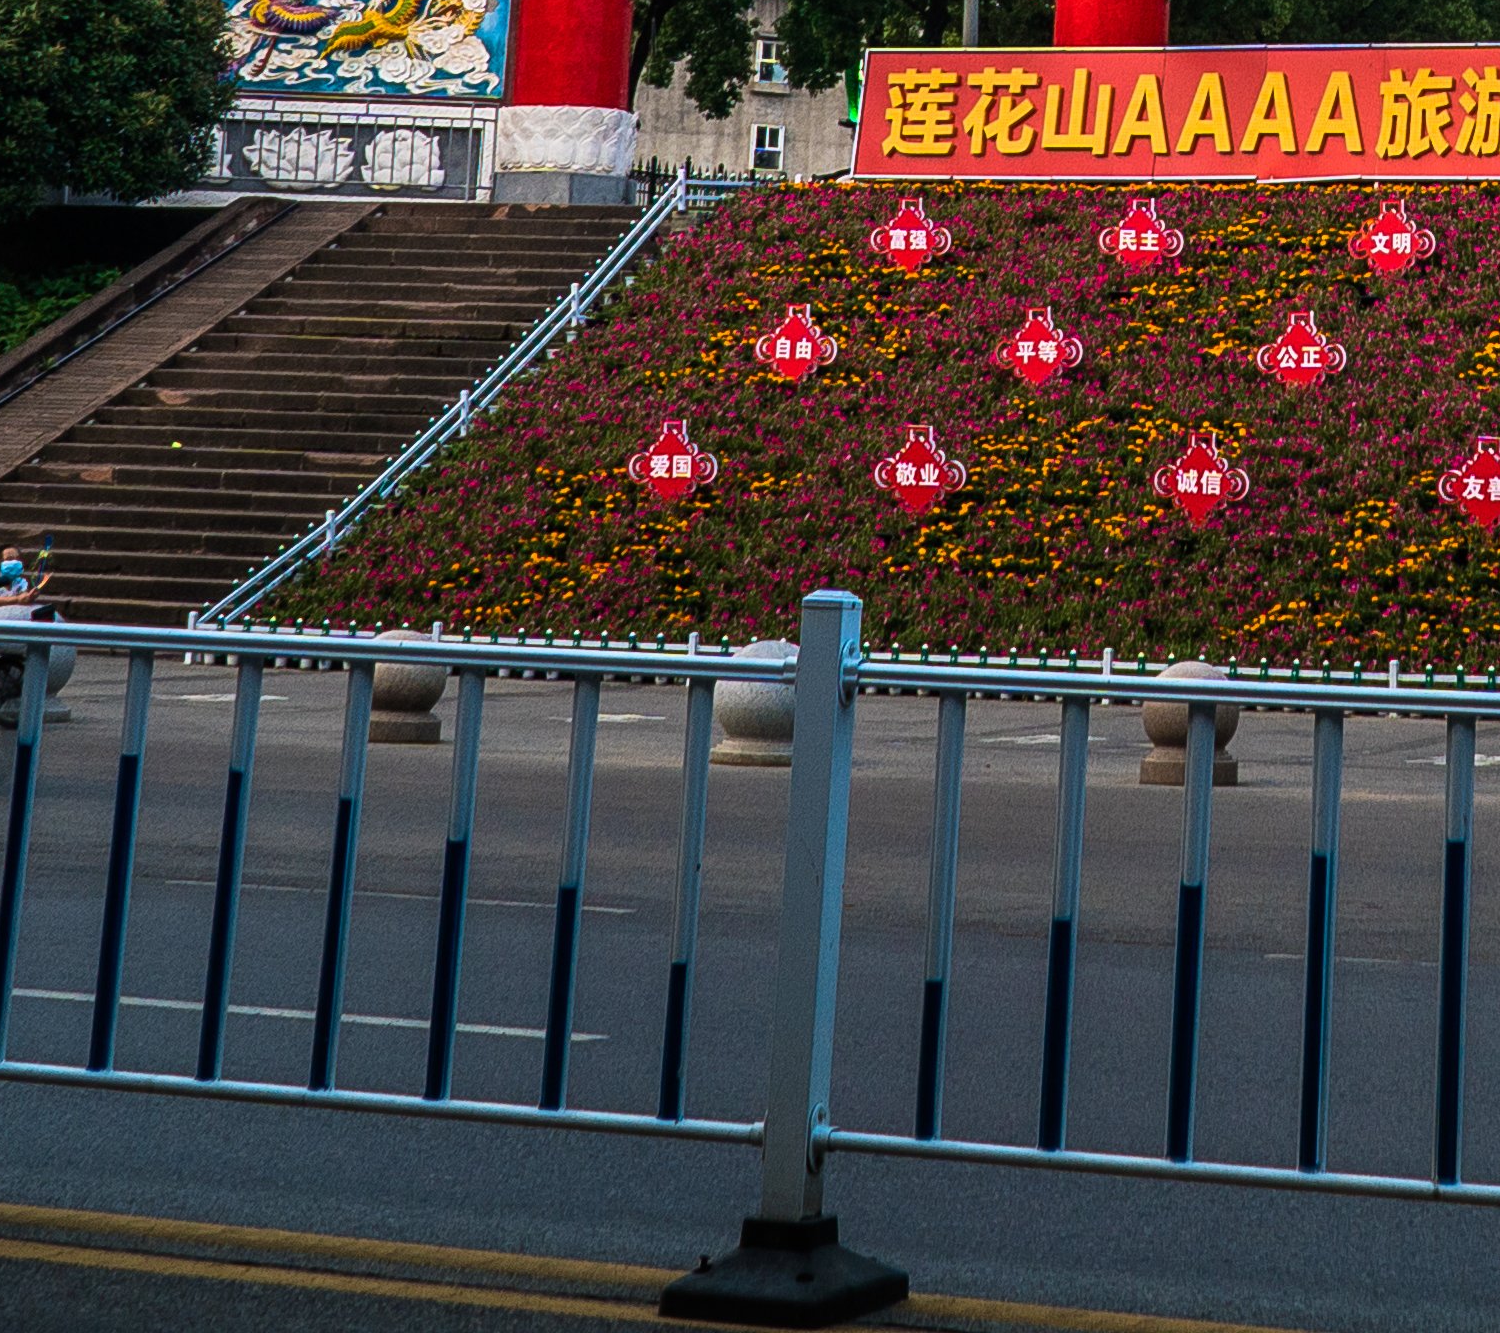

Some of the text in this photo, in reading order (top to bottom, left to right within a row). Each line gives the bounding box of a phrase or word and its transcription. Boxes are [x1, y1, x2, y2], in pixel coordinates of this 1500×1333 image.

[888, 230, 928, 251] 富强
[1118, 231, 1160, 252] 民主
[1370, 233, 1412, 255] 文明
[774, 338, 812, 360] 自由
[1015, 341, 1058, 363] 平等
[1277, 346, 1322, 368] 公正
[650, 456, 692, 479] 爱国
[895, 463, 940, 486] 敬业
[1175, 470, 1223, 495] 诚信
